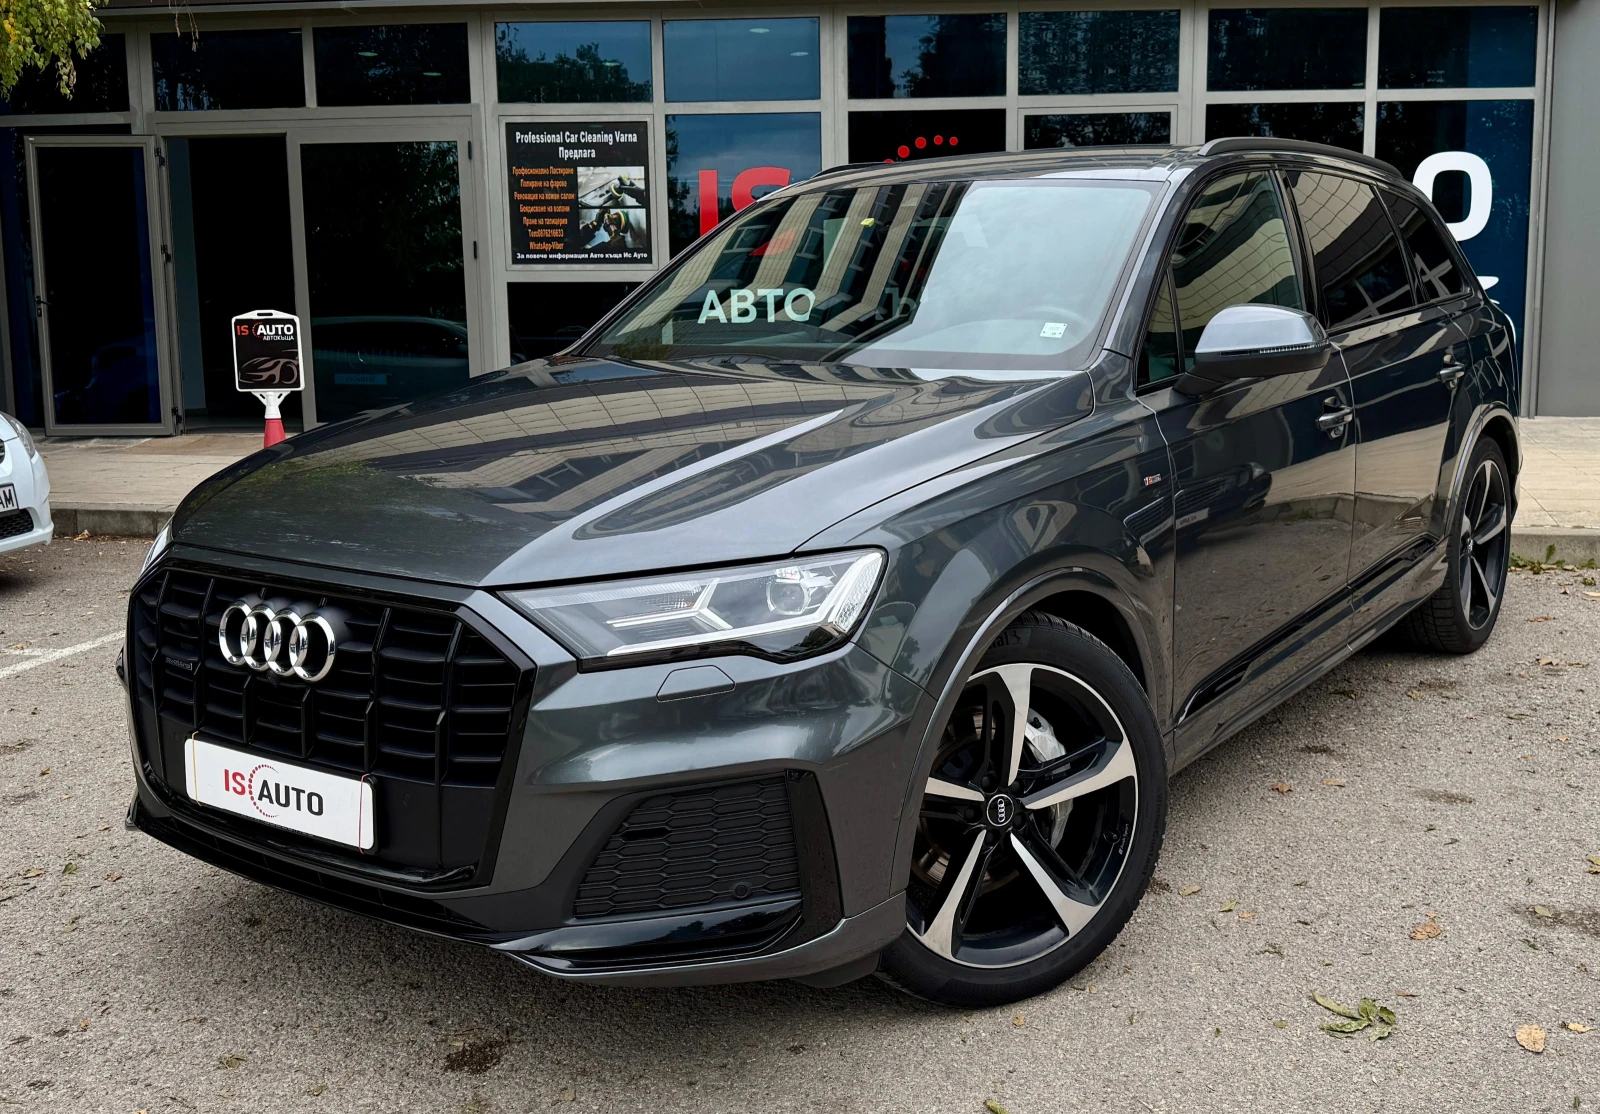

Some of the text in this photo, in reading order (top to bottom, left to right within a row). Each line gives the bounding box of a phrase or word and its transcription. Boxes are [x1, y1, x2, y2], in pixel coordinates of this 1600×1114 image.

[515, 131, 638, 145] Professional Car Cleaning Varna
[558, 147, 596, 160] Предлага
[548, 252, 589, 260] информация
[633, 252, 648, 260] Ауто
[236, 324, 294, 336] IS AUTO
[223, 768, 324, 817] IS AUTO
